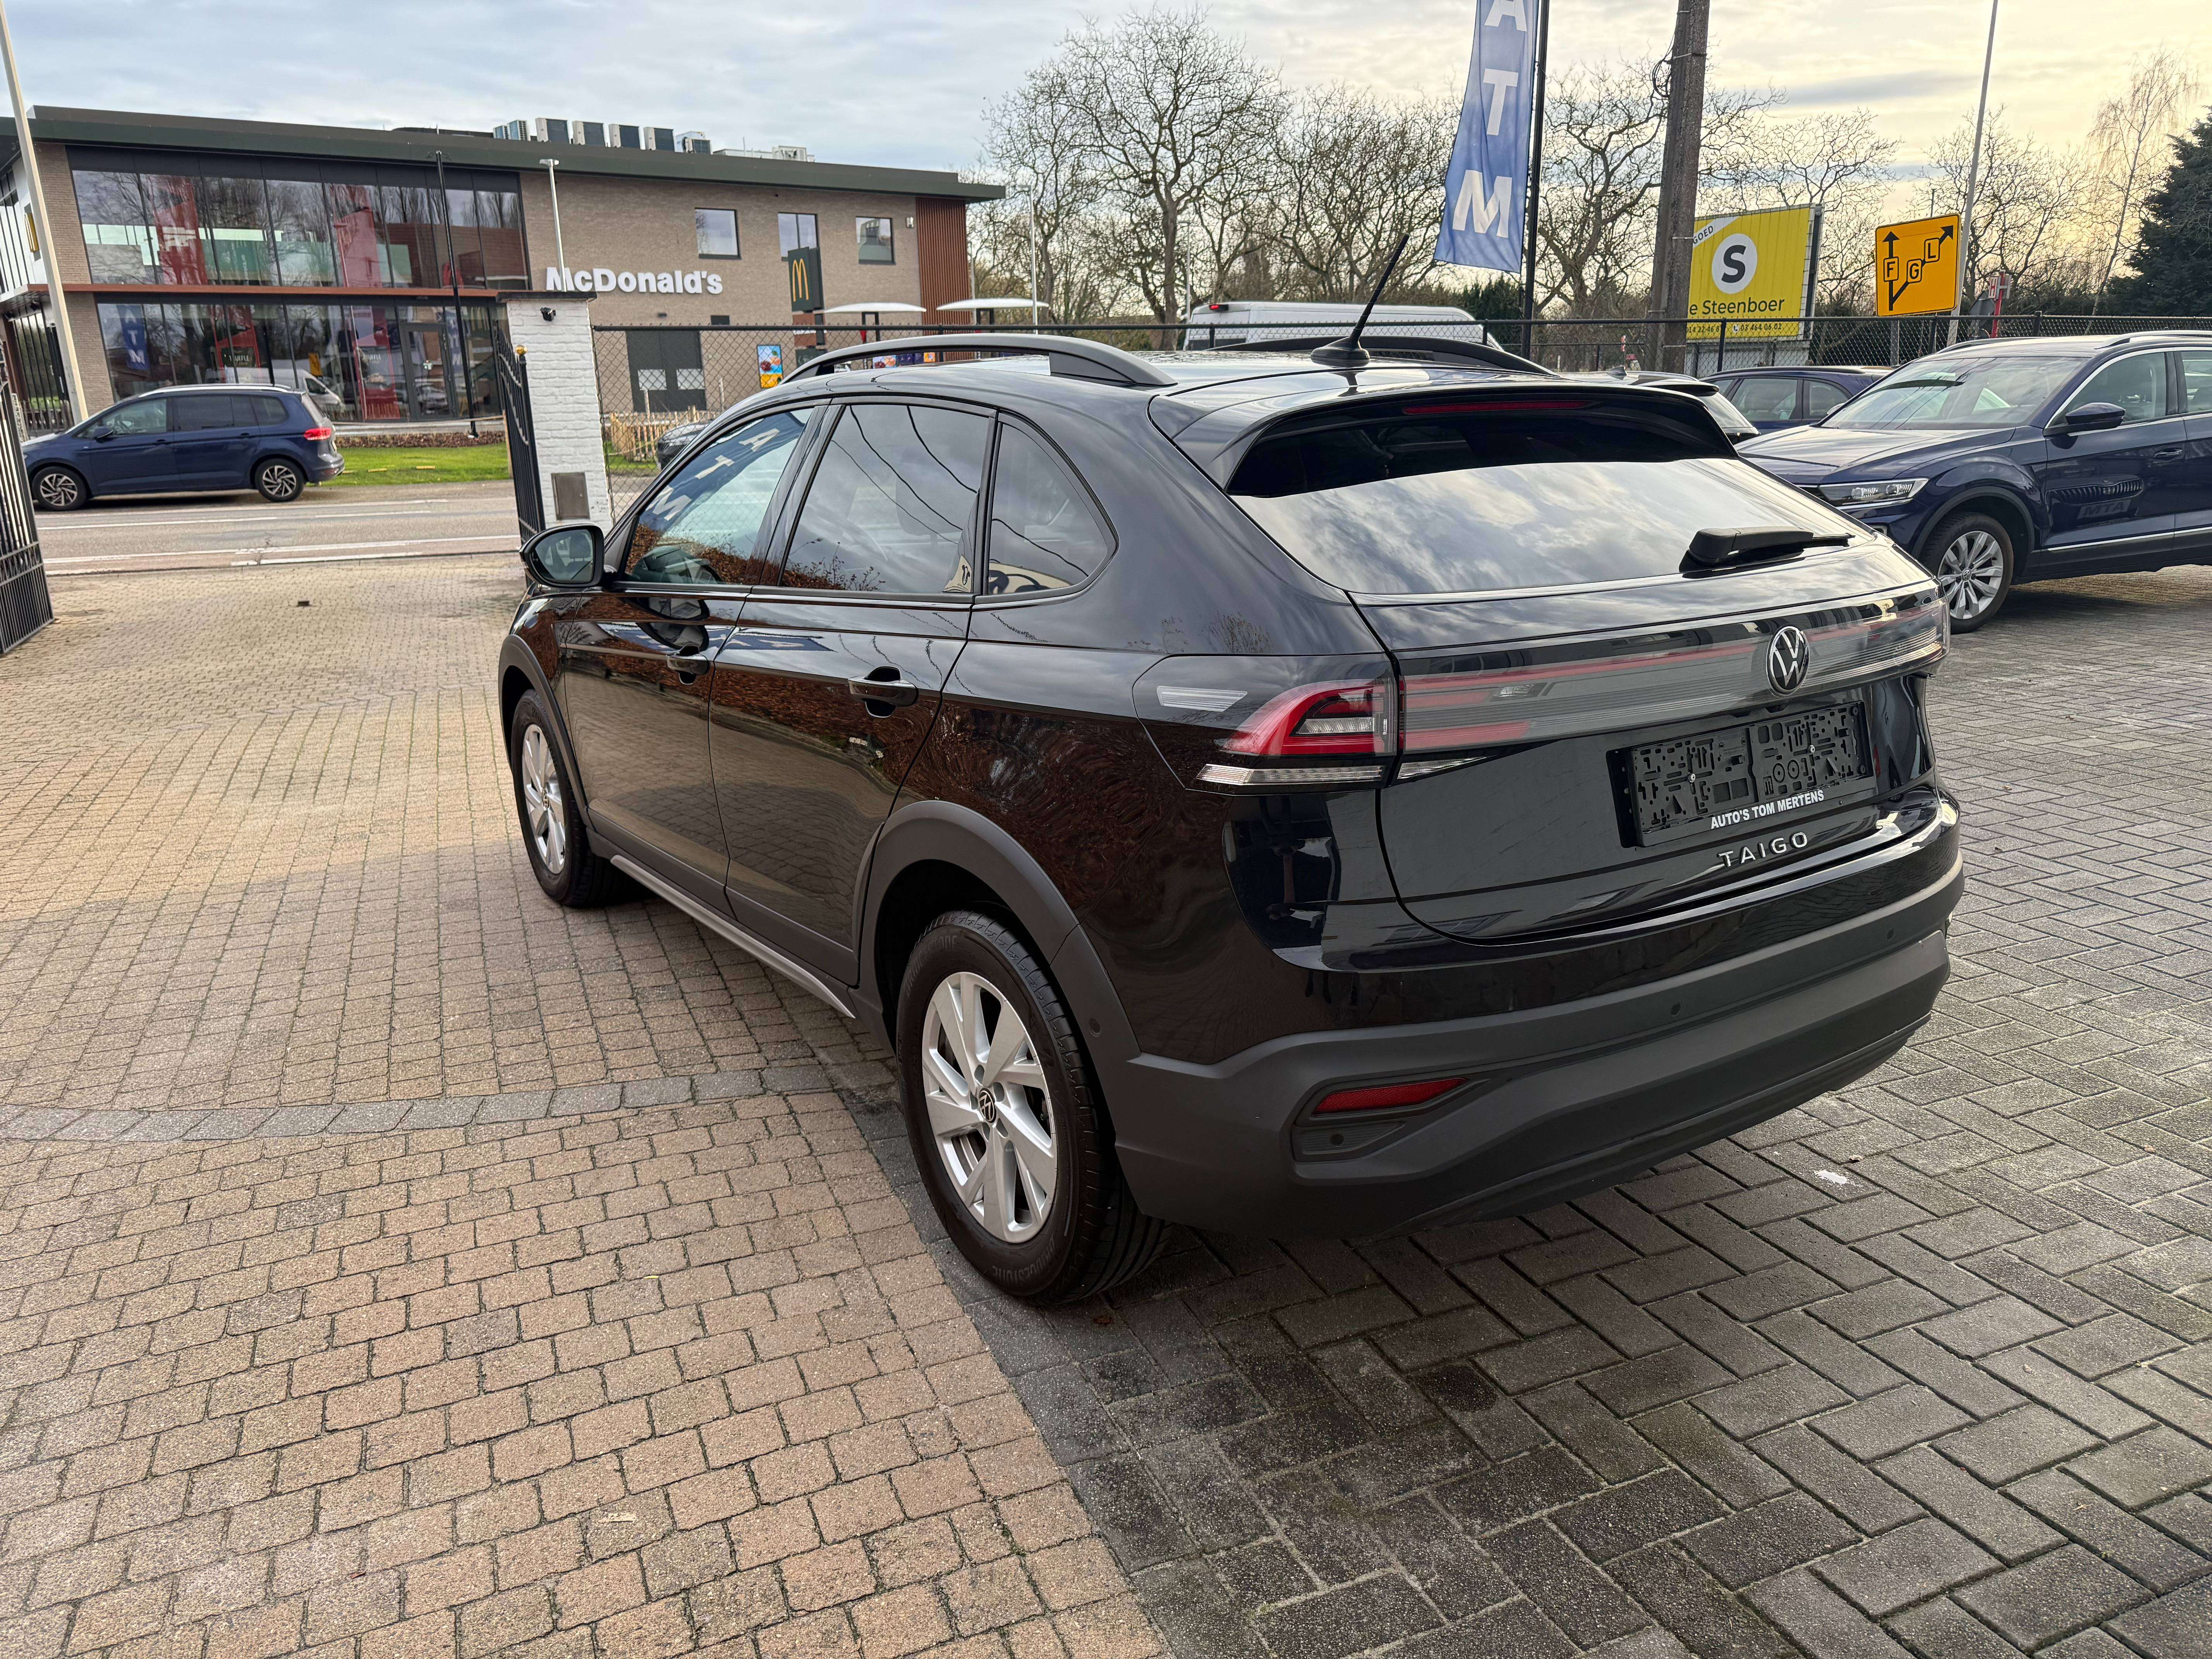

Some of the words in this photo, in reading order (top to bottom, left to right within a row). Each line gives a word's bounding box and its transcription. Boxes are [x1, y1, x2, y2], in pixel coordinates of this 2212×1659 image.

[1927, 243, 1936, 259] L
[1721, 245, 1747, 283] S
[1887, 261, 1896, 277] F
[1910, 263, 1919, 280] G
[546, 267, 723, 294] McDonald's
[1702, 297, 1785, 314] Steenboer
[1711, 809, 1750, 829] AUTO'S
[1752, 802, 1775, 818] TOM
[1777, 790, 1824, 812] MERTENS
[1718, 832, 1808, 867] TAIGO
